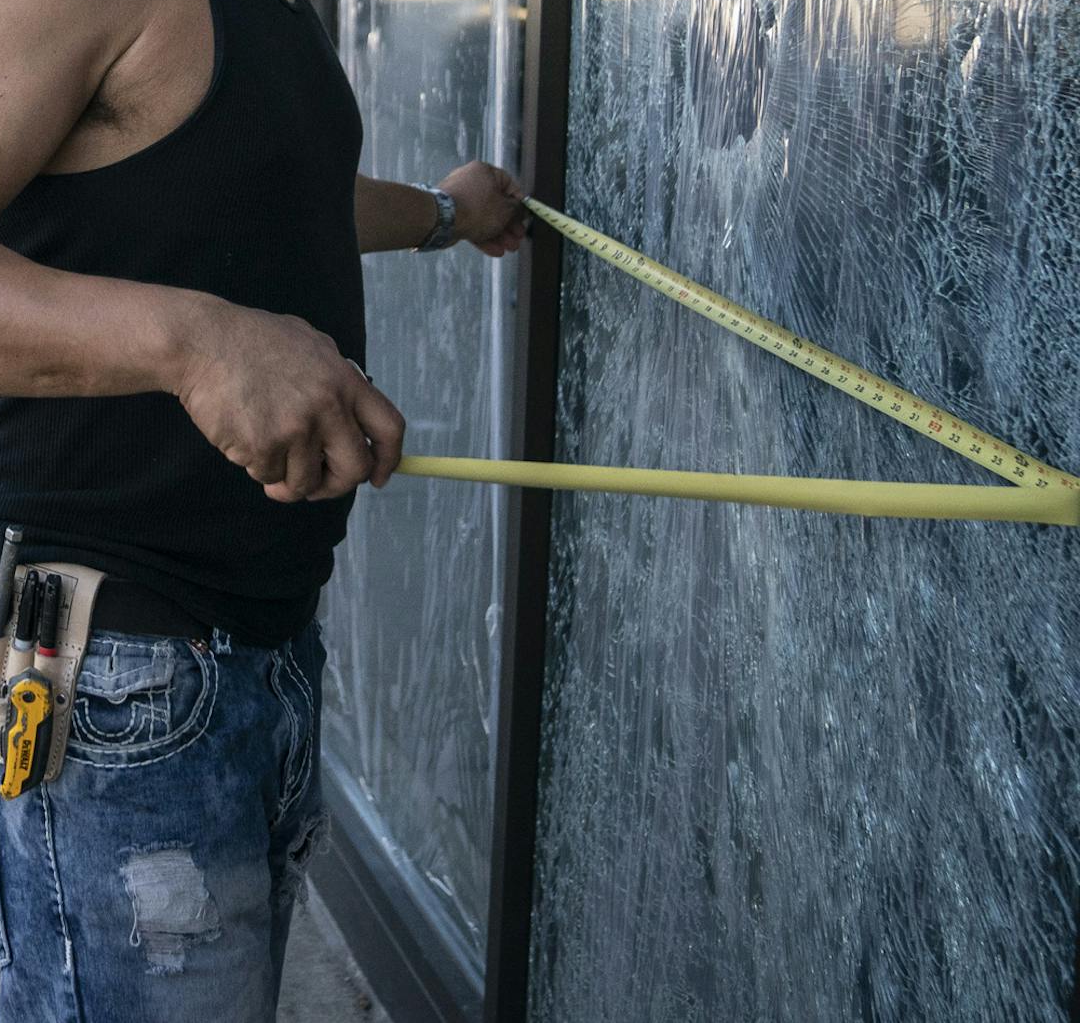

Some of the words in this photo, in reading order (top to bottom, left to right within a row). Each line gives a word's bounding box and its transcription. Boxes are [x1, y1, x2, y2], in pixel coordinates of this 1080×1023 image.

[821, 367, 830, 375] 26
[854, 384, 865, 393] 28
[873, 393, 883, 402] 29
[890, 403, 901, 412] 30
[909, 412, 919, 421] 31
[949, 433, 960, 443] 33
[970, 444, 981, 454] 34
[991, 455, 1003, 465] 35
[1013, 466, 1024, 477] 36
[1035, 478, 1048, 488] 37
